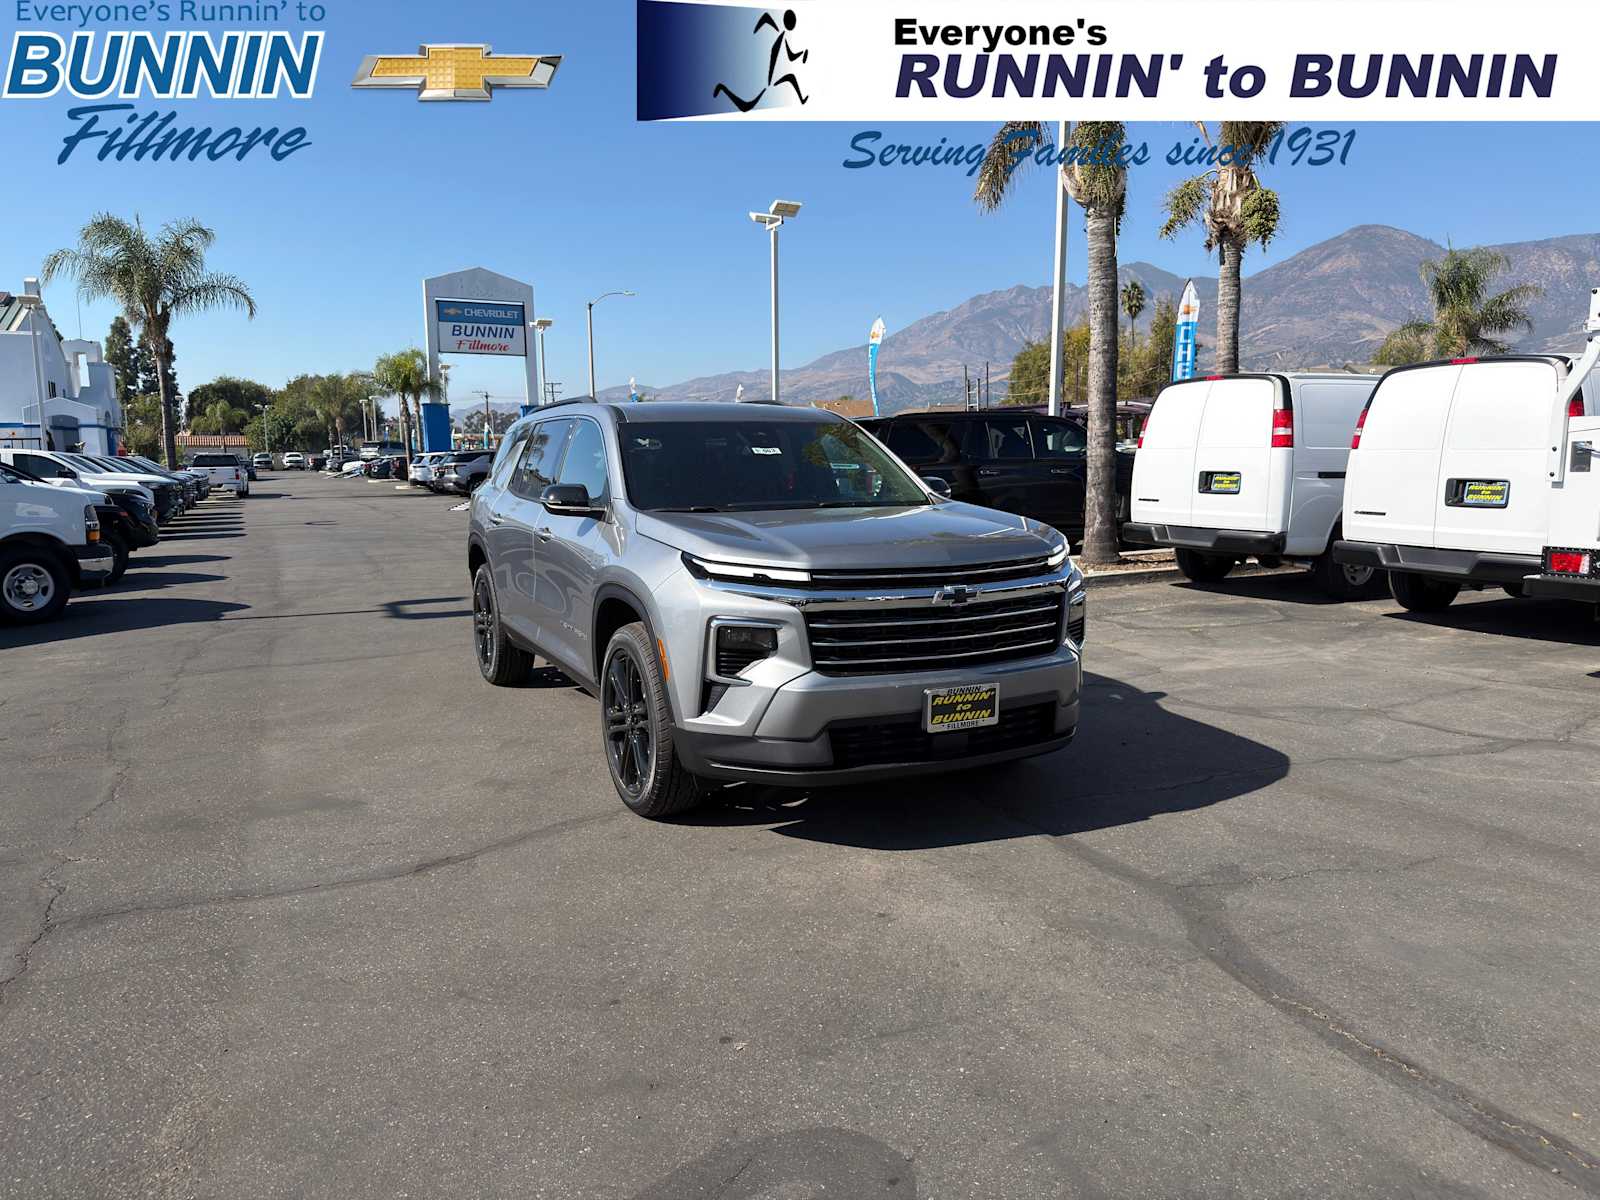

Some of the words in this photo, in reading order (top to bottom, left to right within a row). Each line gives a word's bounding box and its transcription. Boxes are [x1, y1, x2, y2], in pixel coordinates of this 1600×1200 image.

[464, 308, 518, 319] CHEVROLET
[451, 324, 515, 339] BUNNIN
[456, 339, 511, 352] Fillmore
[932, 709, 991, 724] BUNNIN
